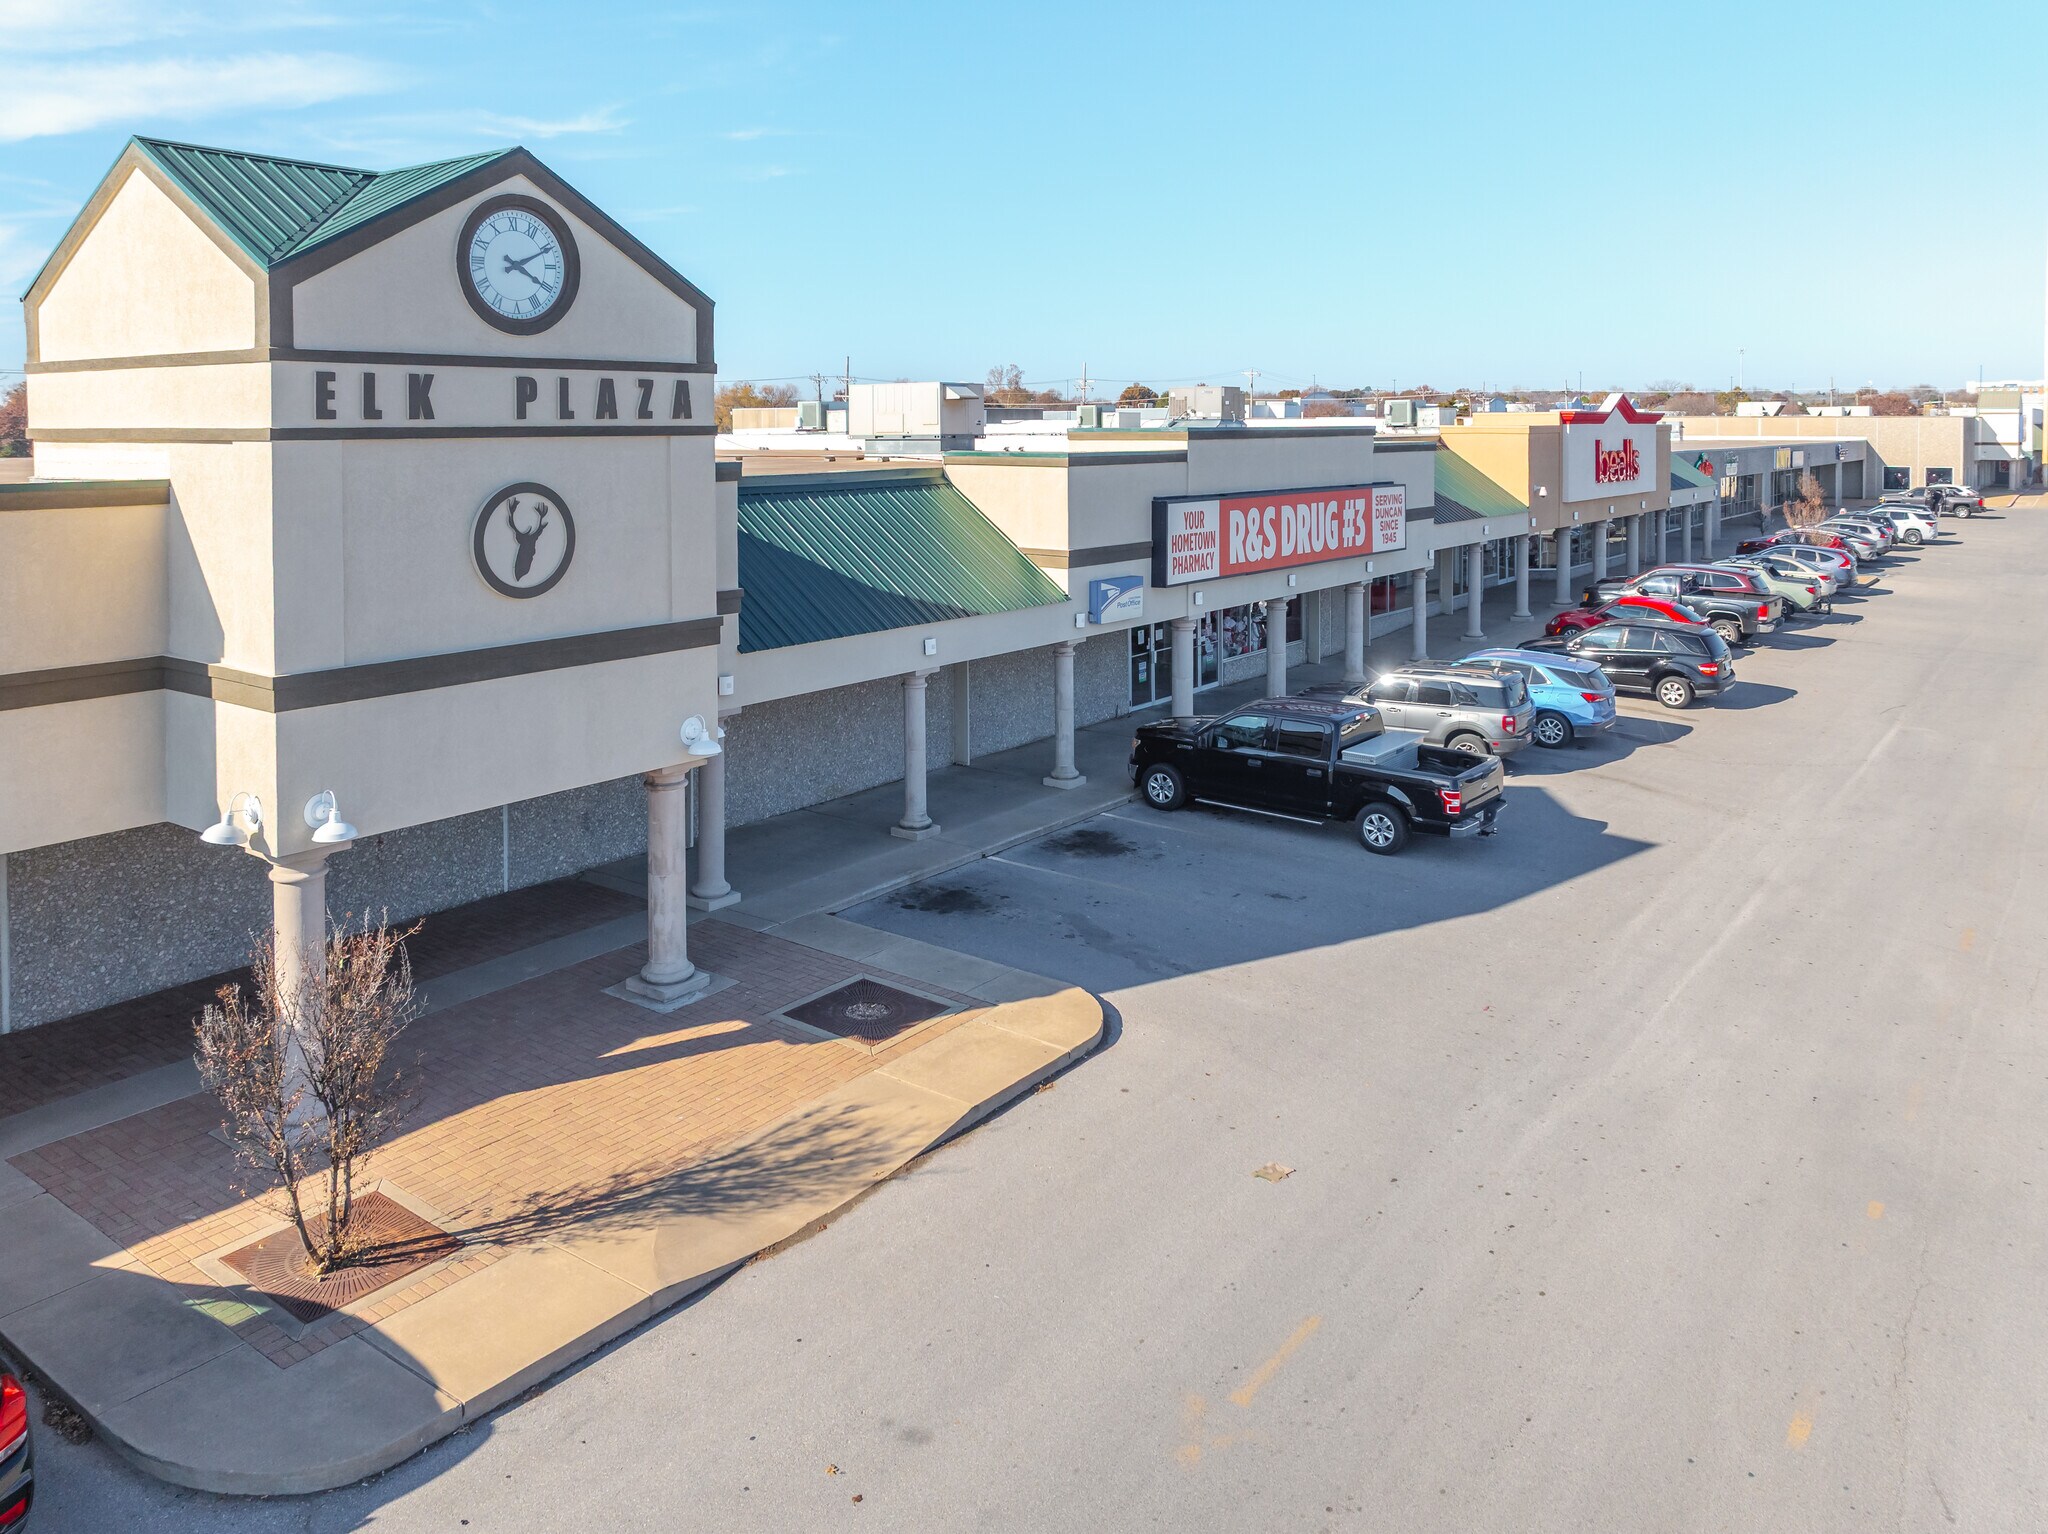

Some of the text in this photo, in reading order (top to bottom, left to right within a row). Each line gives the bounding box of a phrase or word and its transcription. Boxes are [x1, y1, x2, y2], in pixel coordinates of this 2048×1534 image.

[314, 371, 693, 421] ELK PLAZA
[1595, 439, 1640, 483] bealls
[1375, 494, 1403, 507] SERVING
[1183, 510, 1205, 530] YOUR
[1375, 506, 1403, 519] DUNCAN
[1229, 498, 1366, 565] R&S DRUG #3
[1380, 519, 1399, 531] SINCE
[1171, 530, 1216, 554] HOMETOWN
[1382, 532, 1397, 544] 1945
[1172, 553, 1215, 576] PHARMACY
